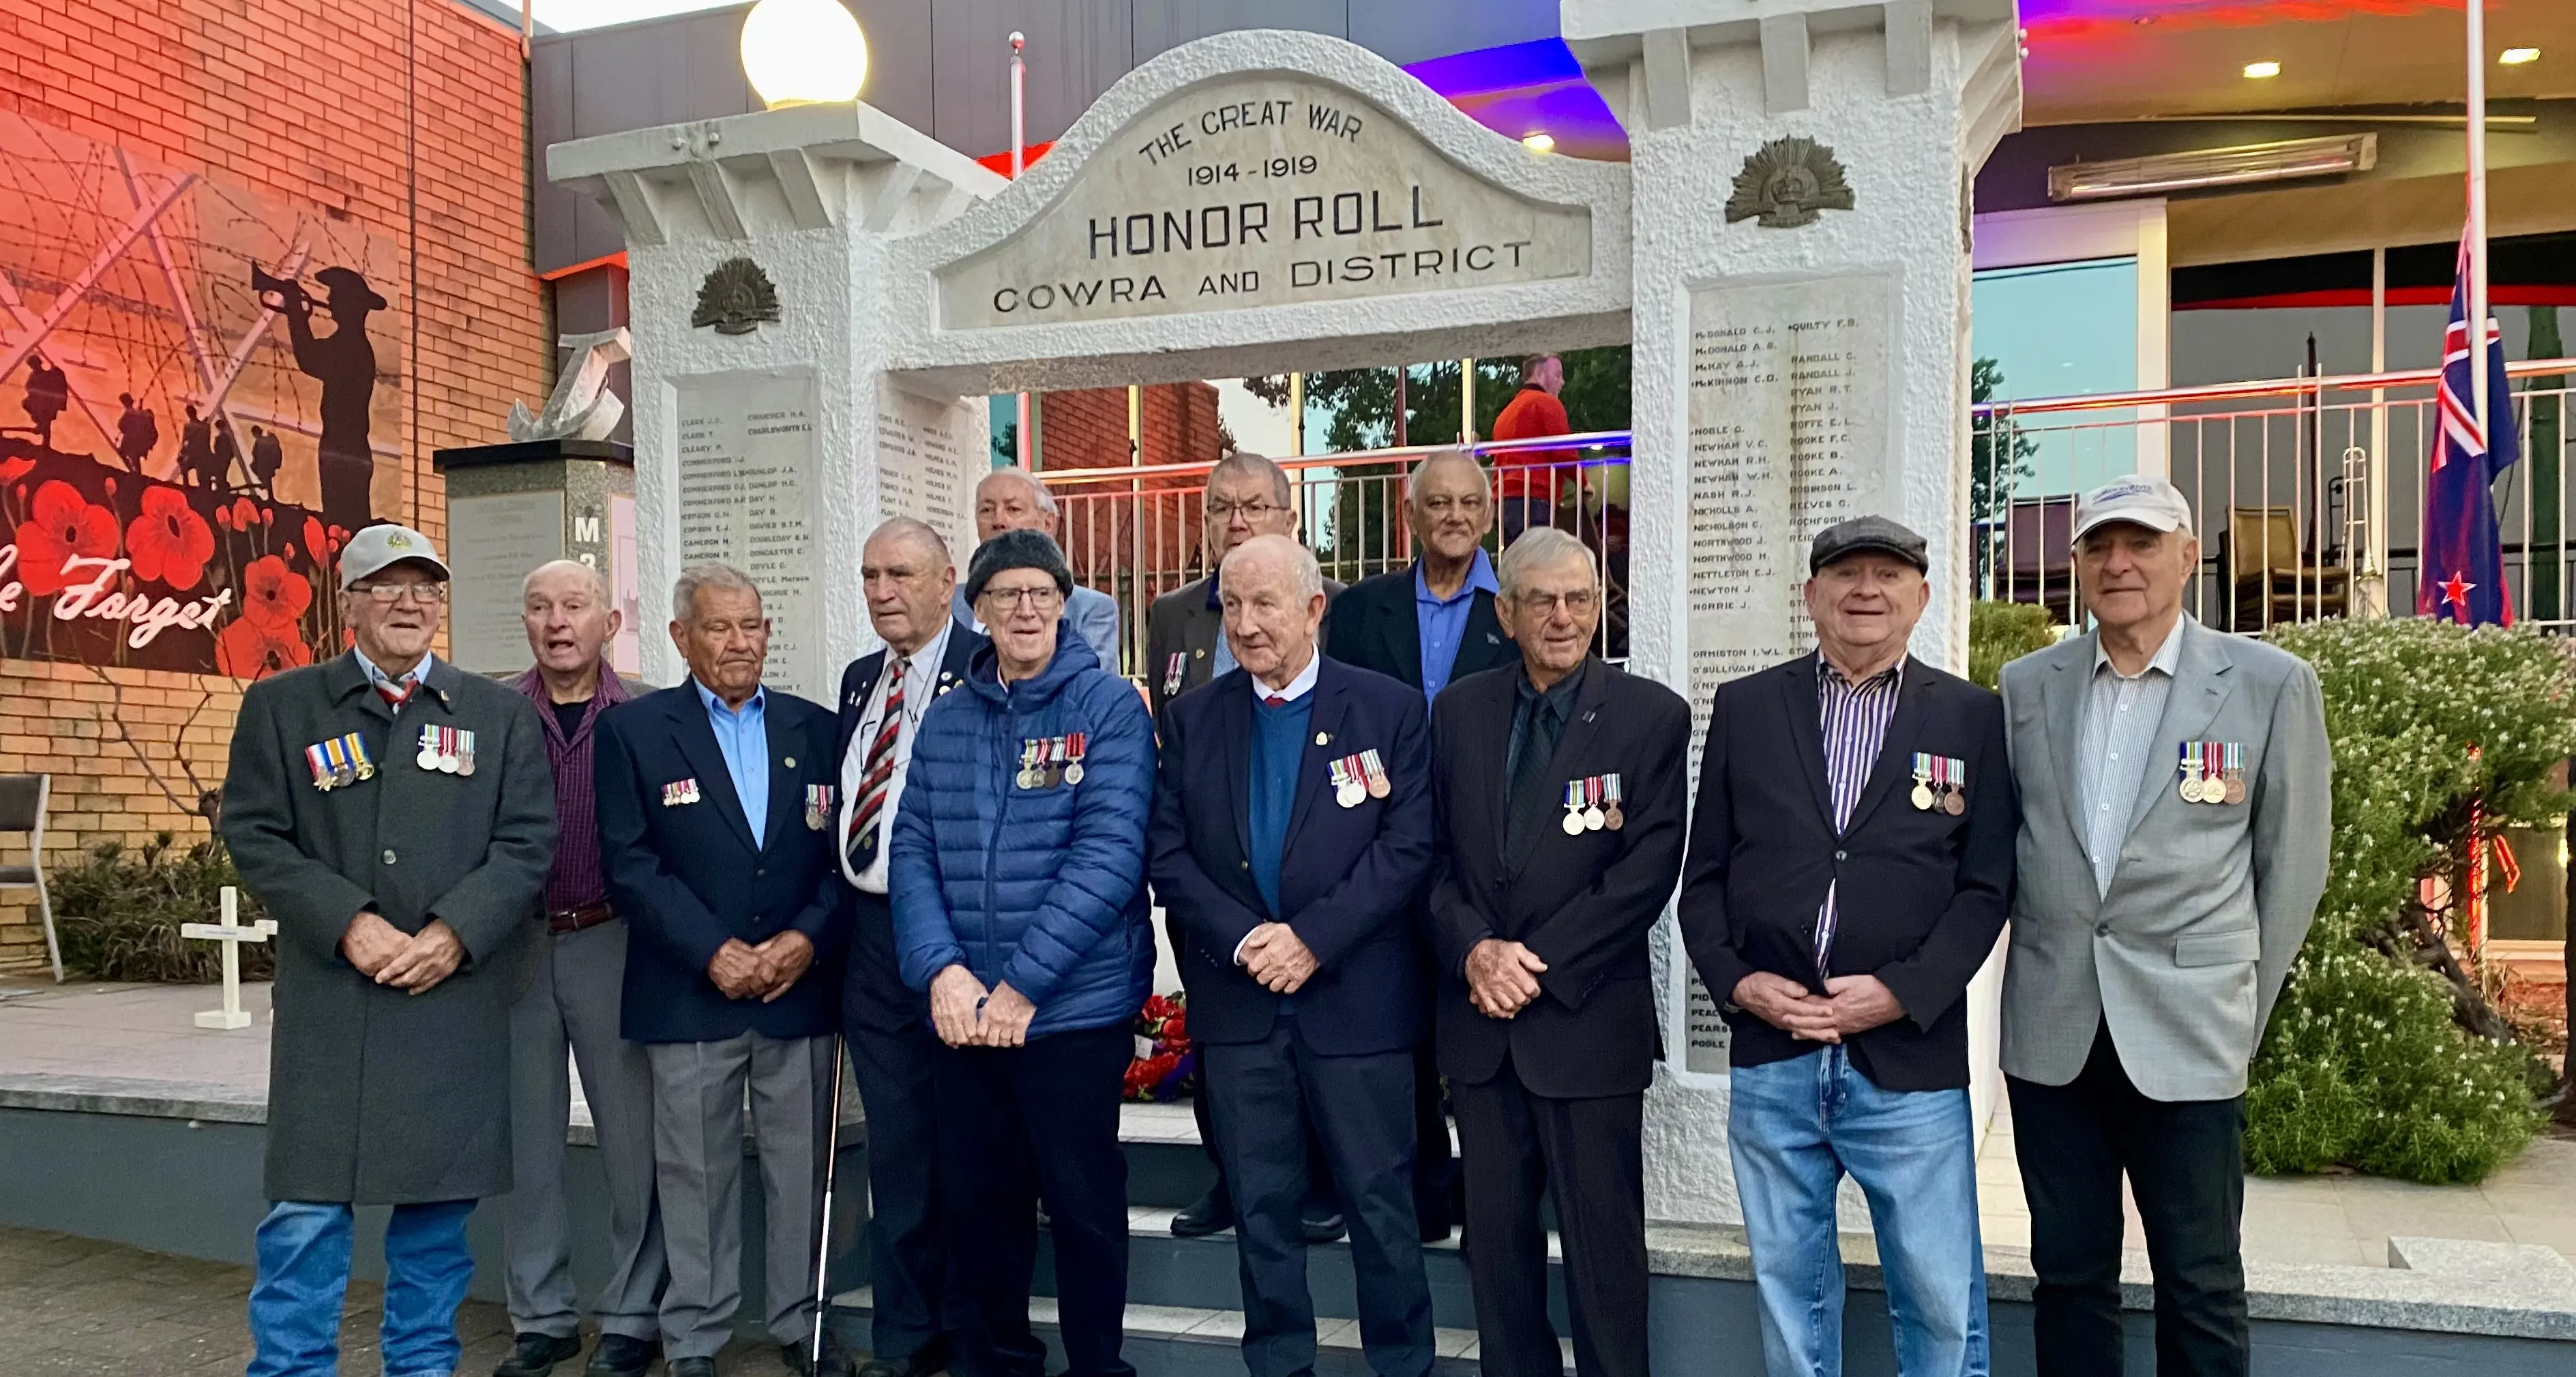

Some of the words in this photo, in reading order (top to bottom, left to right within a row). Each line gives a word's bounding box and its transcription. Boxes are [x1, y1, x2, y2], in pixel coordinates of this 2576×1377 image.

[1138, 122, 1192, 166] THE
[1201, 100, 1292, 136] GREAT
[1308, 103, 1363, 143] WAR
[1089, 201, 1269, 260] HONOR
[1294, 185, 1445, 239] ROLL
[994, 275, 1168, 314] COWRA
[1198, 269, 1260, 296] AND
[1291, 241, 1532, 288] DISTRICT
[1791, 353, 1840, 364] RANDALL
[1791, 370, 1840, 381] RANDALL
[1790, 386, 1822, 398] RYAN
[1790, 403, 1822, 414] RYAN
[1694, 426, 1728, 436] NOBLE
[1790, 434, 1825, 445] ROOKE
[1790, 451, 1825, 462] ROOKE
[1790, 468, 1825, 479] ROOKE
[1790, 483, 1841, 494] ROBINSON
[1693, 490, 1726, 500] NASH
[574, 516, 599, 544] M
[1693, 537, 1753, 547] NORTHWOOD
[1693, 552, 1753, 563] NORTHWOOD
[1693, 569, 1749, 579] NETTLETON
[1693, 585, 1739, 595] NEWTON
[53, 553, 232, 649] Forget
[1693, 601, 1734, 611] NORRIE
[1693, 648, 1747, 659] ORMISTON
[1691, 1039, 1725, 1048] POOLE
